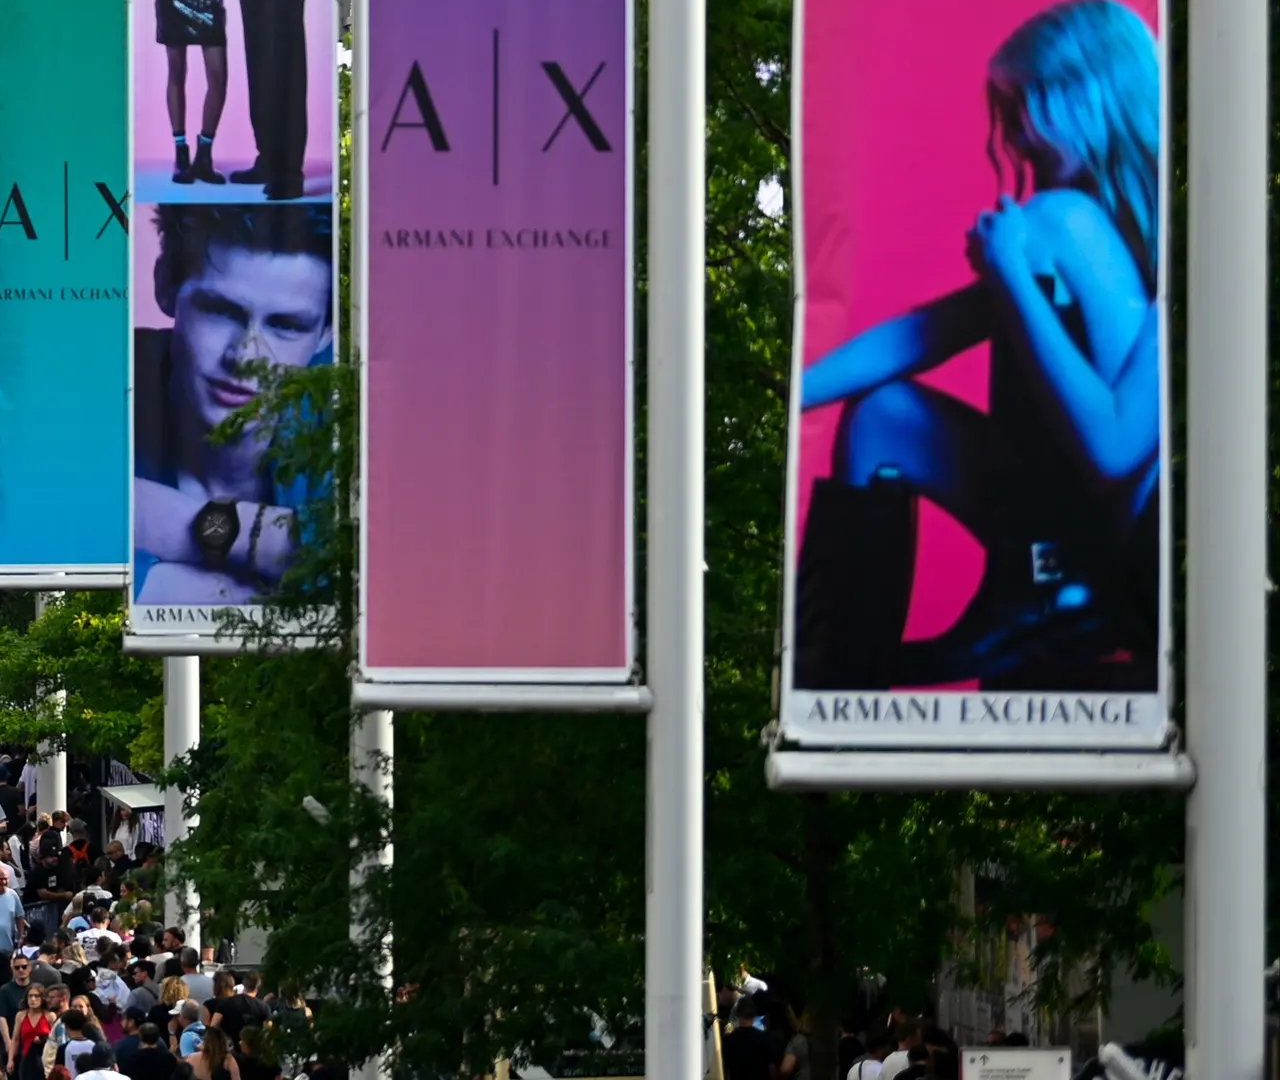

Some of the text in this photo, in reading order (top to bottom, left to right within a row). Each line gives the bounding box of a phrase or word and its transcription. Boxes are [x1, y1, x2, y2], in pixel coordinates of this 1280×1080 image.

[381, 228, 612, 249] ARMANI EXCHANGE
[144, 607, 216, 623] ARMANI
[807, 695, 1140, 725] ARMANI EXCHANGE
